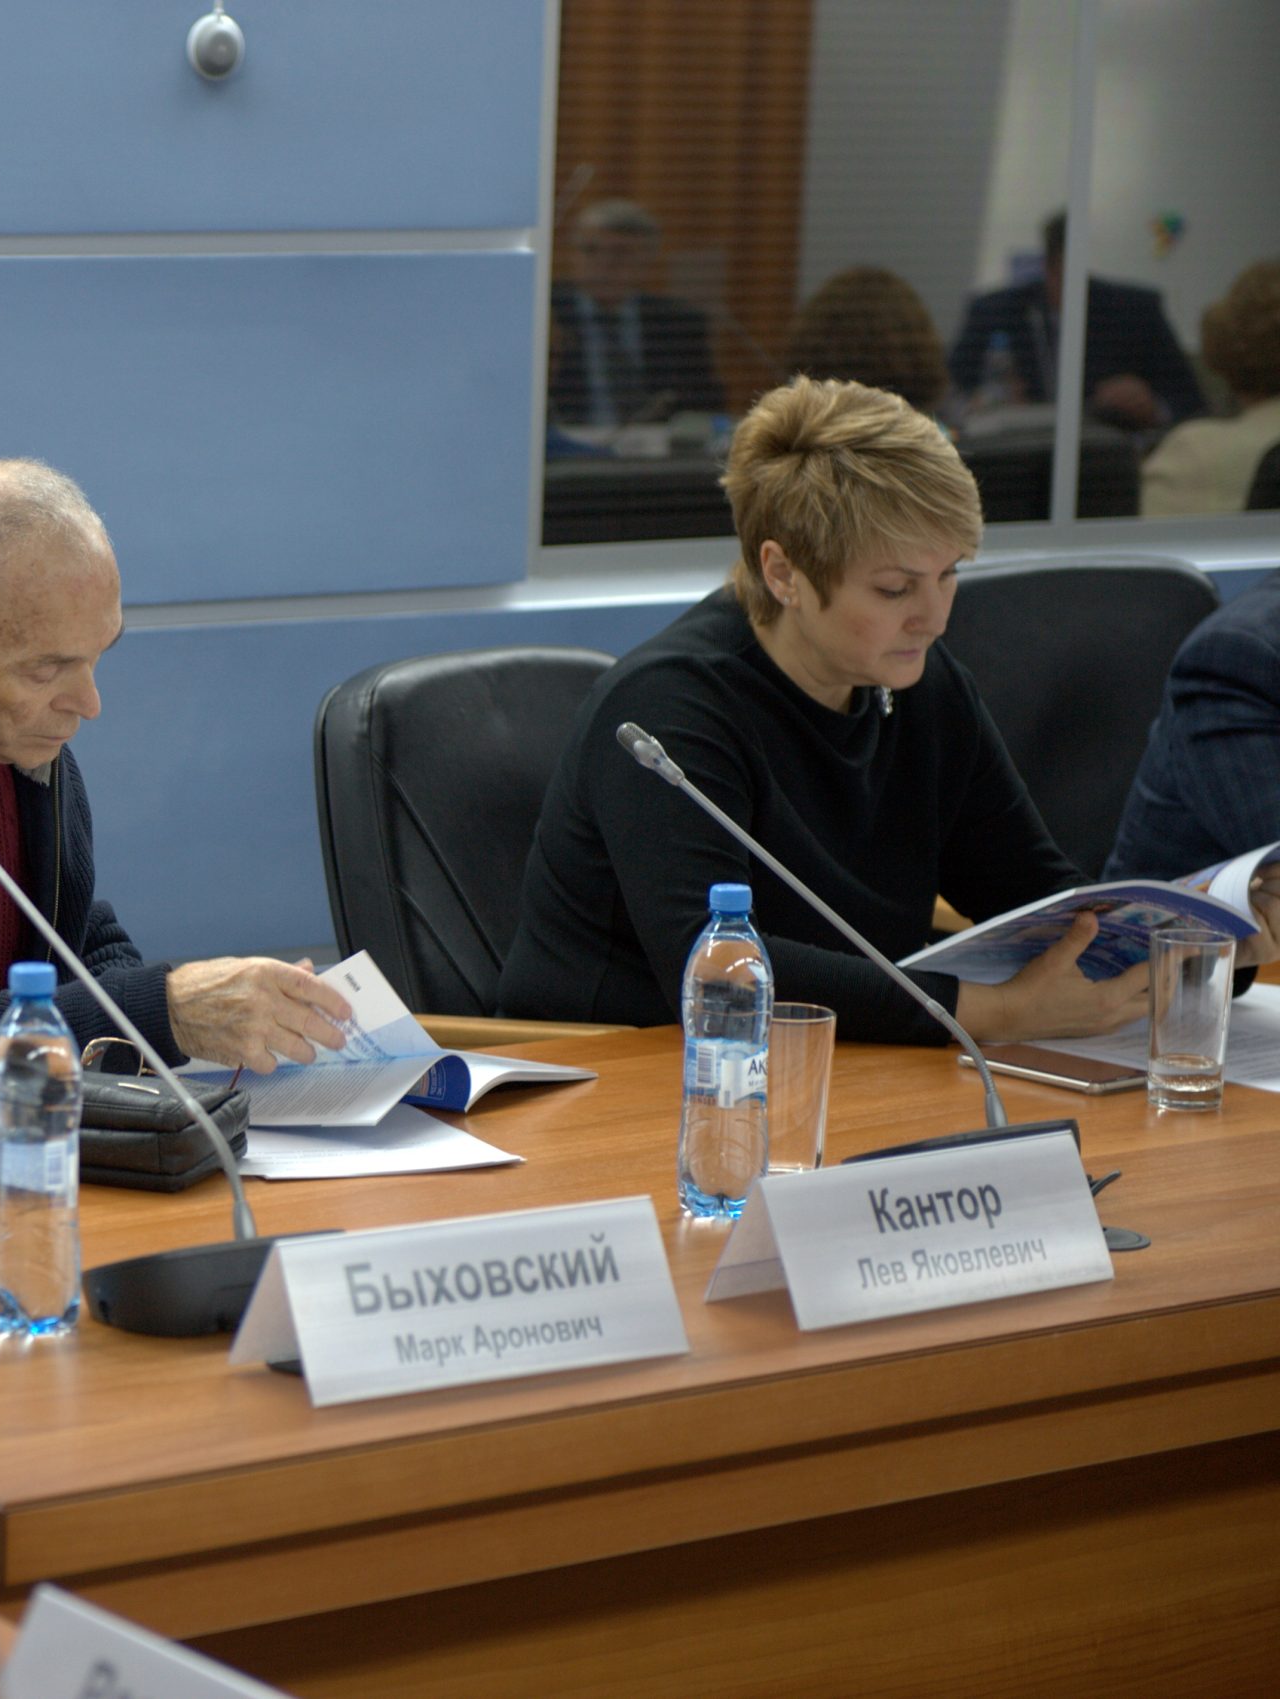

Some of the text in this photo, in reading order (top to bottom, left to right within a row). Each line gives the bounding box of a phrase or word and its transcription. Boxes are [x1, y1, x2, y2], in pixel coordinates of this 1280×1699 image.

[868, 1182, 1004, 1233] Кантор
[343, 1231, 621, 1317] Быховский
[857, 1238, 1048, 1290] Лев Яковлевич
[393, 1314, 604, 1367] Марк Аронович
